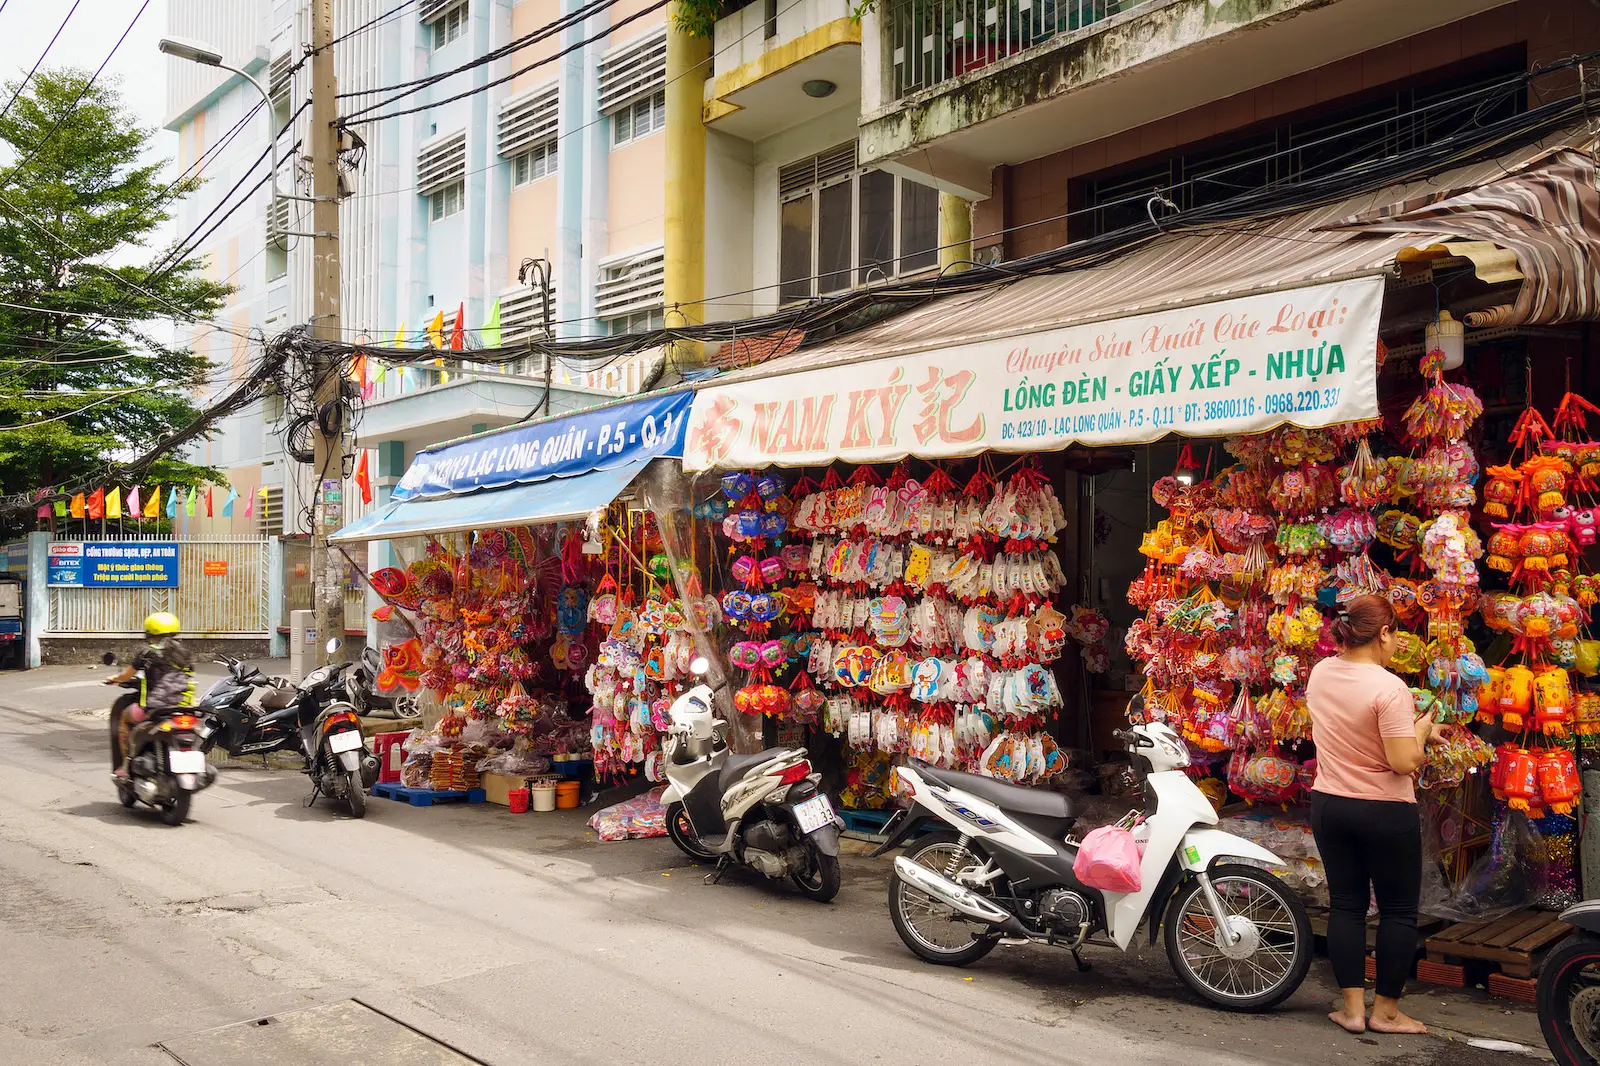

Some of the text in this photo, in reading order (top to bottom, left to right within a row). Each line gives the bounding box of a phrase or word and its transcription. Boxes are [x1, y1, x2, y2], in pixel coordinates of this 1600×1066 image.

[1006, 298, 1347, 373] Chuyên Sản Xuất Các Loại:
[750, 393, 838, 455] NAM
[839, 366, 913, 449] KÝ
[913, 365, 986, 446] 記
[1003, 376, 1056, 412] LỒNG
[1062, 372, 1107, 405] ĐÈN
[1128, 357, 1182, 397] GIẤY
[1189, 349, 1240, 390] XẾP
[1266, 340, 1346, 382] NHỰA
[467, 447, 498, 484] LẠC
[496, 440, 540, 473] LONG
[540, 425, 587, 466] QUÂN
[597, 421, 626, 456] P.5
[1002, 423, 1015, 439] ĐC:
[1017, 419, 1047, 437] 423/10
[1054, 417, 1070, 438] LẠC
[1073, 414, 1095, 433] LONG
[1097, 407, 1122, 433] QUÂN
[1129, 408, 1143, 427] P.5
[1152, 405, 1174, 427] Q.11
[1185, 403, 1200, 422] ĐT:
[1204, 396, 1254, 421] 38600116
